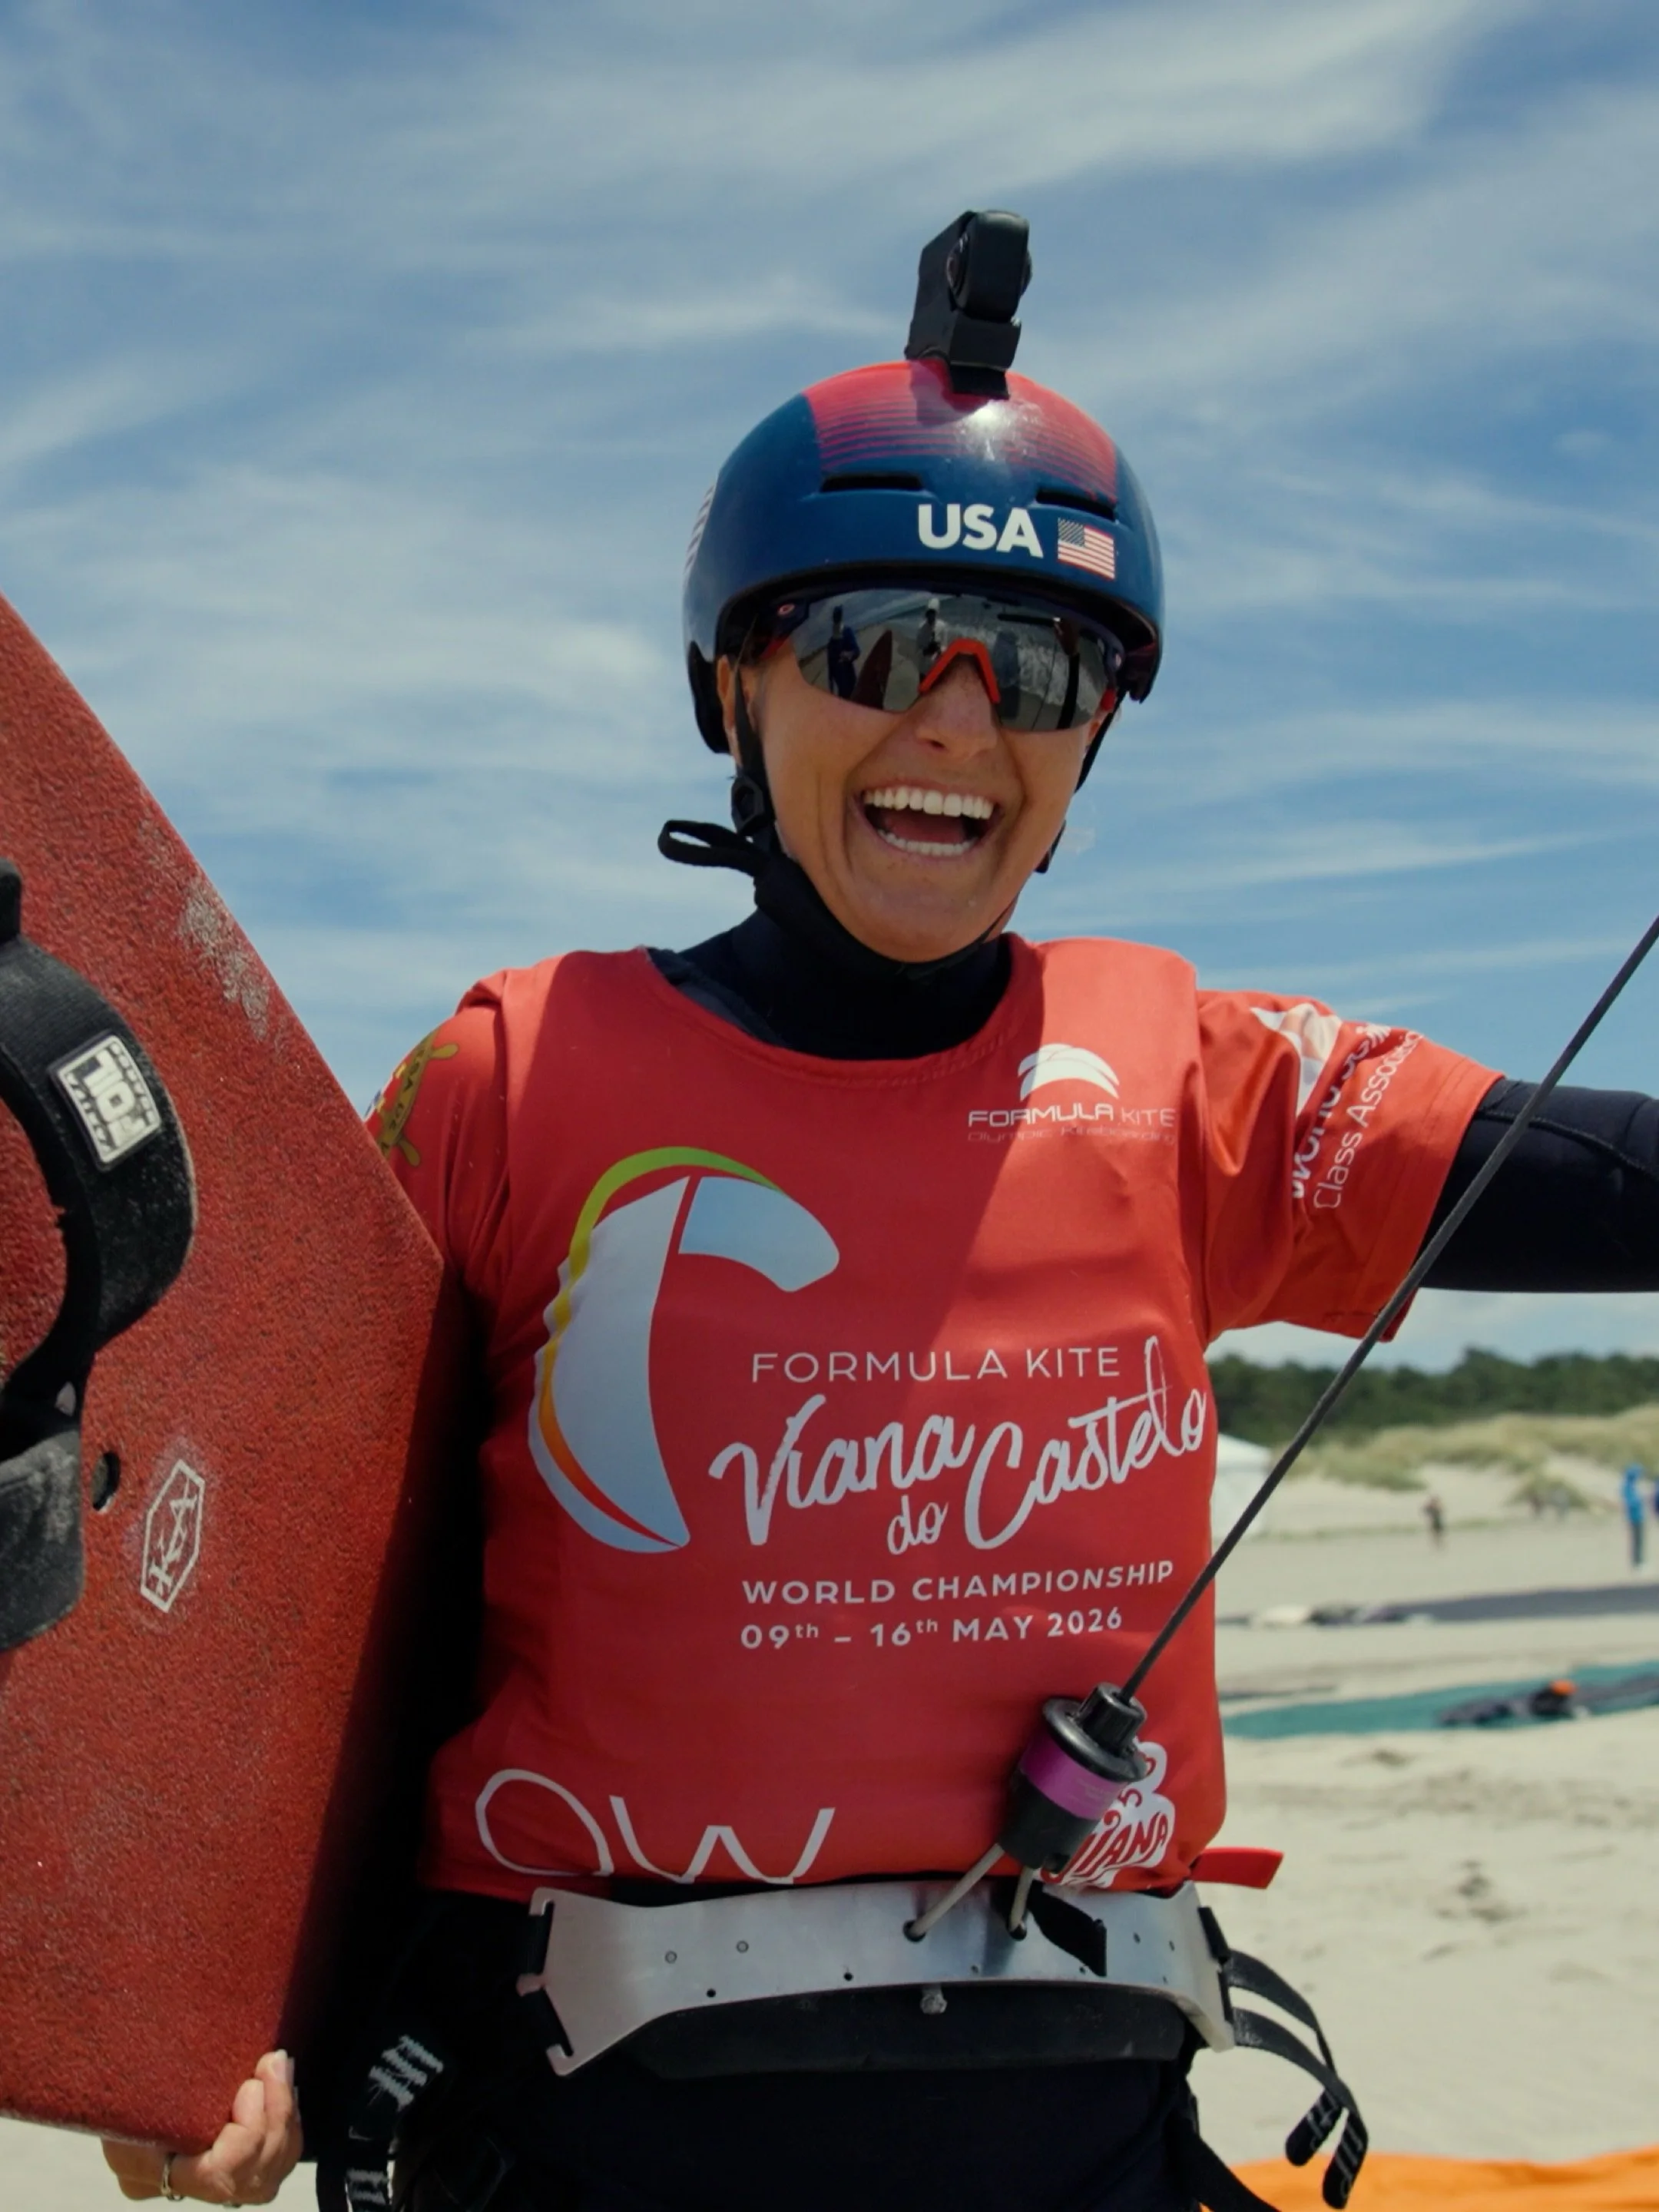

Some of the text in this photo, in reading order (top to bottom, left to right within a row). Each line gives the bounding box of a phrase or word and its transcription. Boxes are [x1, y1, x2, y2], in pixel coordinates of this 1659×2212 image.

[918, 504, 1043, 558] USA
[968, 1103, 1176, 1127] FORMULA KITE
[1313, 1130, 1363, 1209] Class
[752, 1347, 1120, 1382] FORMULA KITE
[709, 1336, 1206, 1555] Viana do Castelo
[742, 1560, 1174, 1604] WORLD CHAMPIONSHIP
[740, 1624, 819, 1649] 09th
[870, 1618, 939, 1647] 16th
[952, 1614, 1033, 1642] MAY
[1048, 1607, 1121, 1637] 2026
